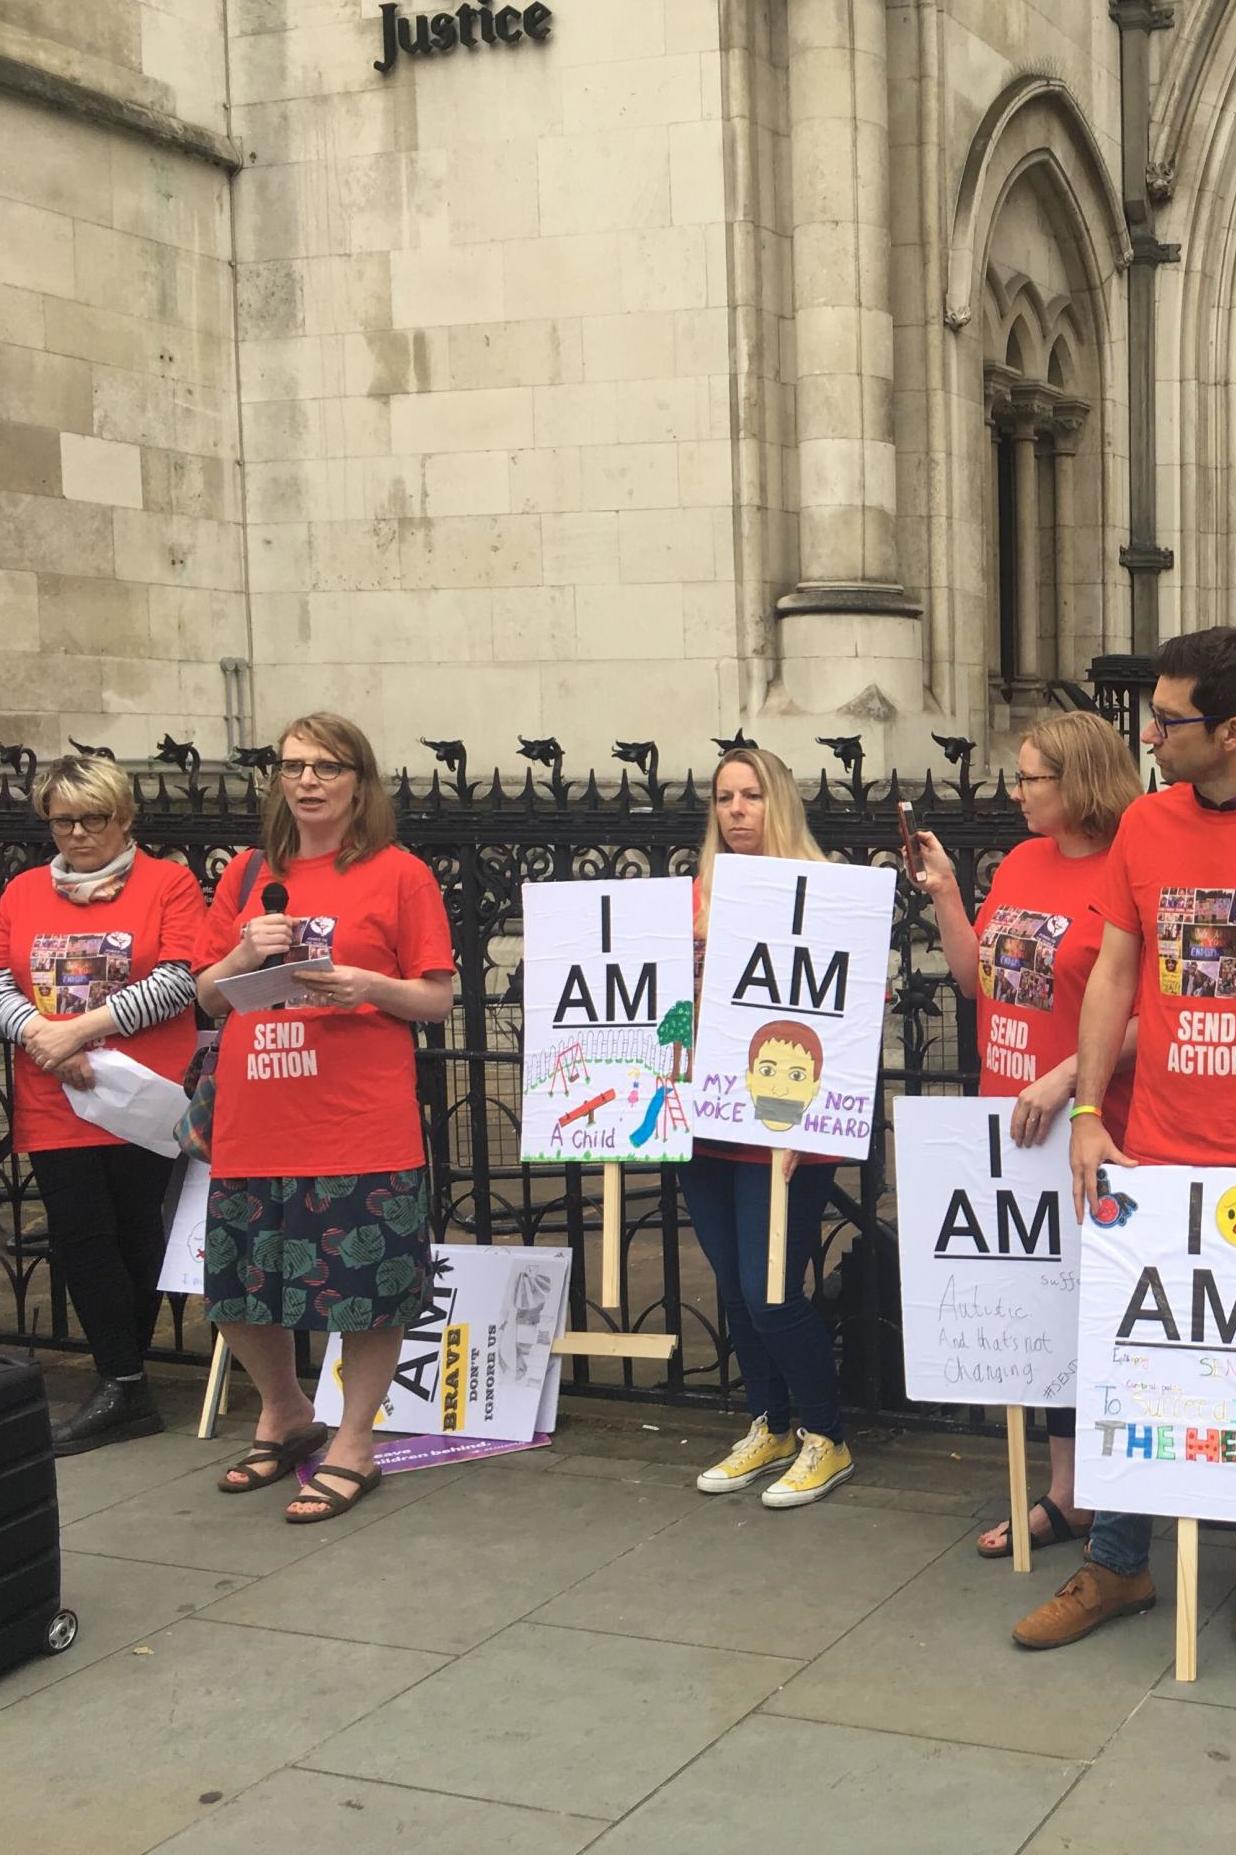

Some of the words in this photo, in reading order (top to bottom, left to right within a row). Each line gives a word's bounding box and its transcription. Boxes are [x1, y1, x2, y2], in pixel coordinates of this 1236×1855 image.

[373, 0, 552, 73] Justice
[601, 895, 612, 953] I
[791, 875, 808, 935] I
[553, 962, 657, 1023] AM
[732, 942, 850, 1012] AM
[253, 1022, 305, 1050] SEND
[990, 1014, 1029, 1050] SEND
[1178, 1011, 1236, 1043] SEND
[247, 1050, 318, 1081] ACTION
[986, 1047, 1036, 1083] ACTION
[703, 1073, 737, 1097] MY
[825, 1091, 870, 1113] NOT
[550, 1124, 564, 1147] A
[572, 1127, 616, 1150] Child
[804, 1114, 871, 1139] HEARD
[988, 1114, 1002, 1178] I
[934, 1189, 1061, 1255] AM
[1188, 1182, 1203, 1255] I
[489, 1324, 497, 1349] US
[938, 1326, 969, 1349] And
[1024, 1332, 1053, 1354] not
[442, 1328, 462, 1432] BRAVE
[469, 1348, 480, 1402] DON'T
[484, 1355, 497, 1421] IGNORE
[1095, 1385, 1122, 1416] To
[1095, 1420, 1176, 1461] THE
